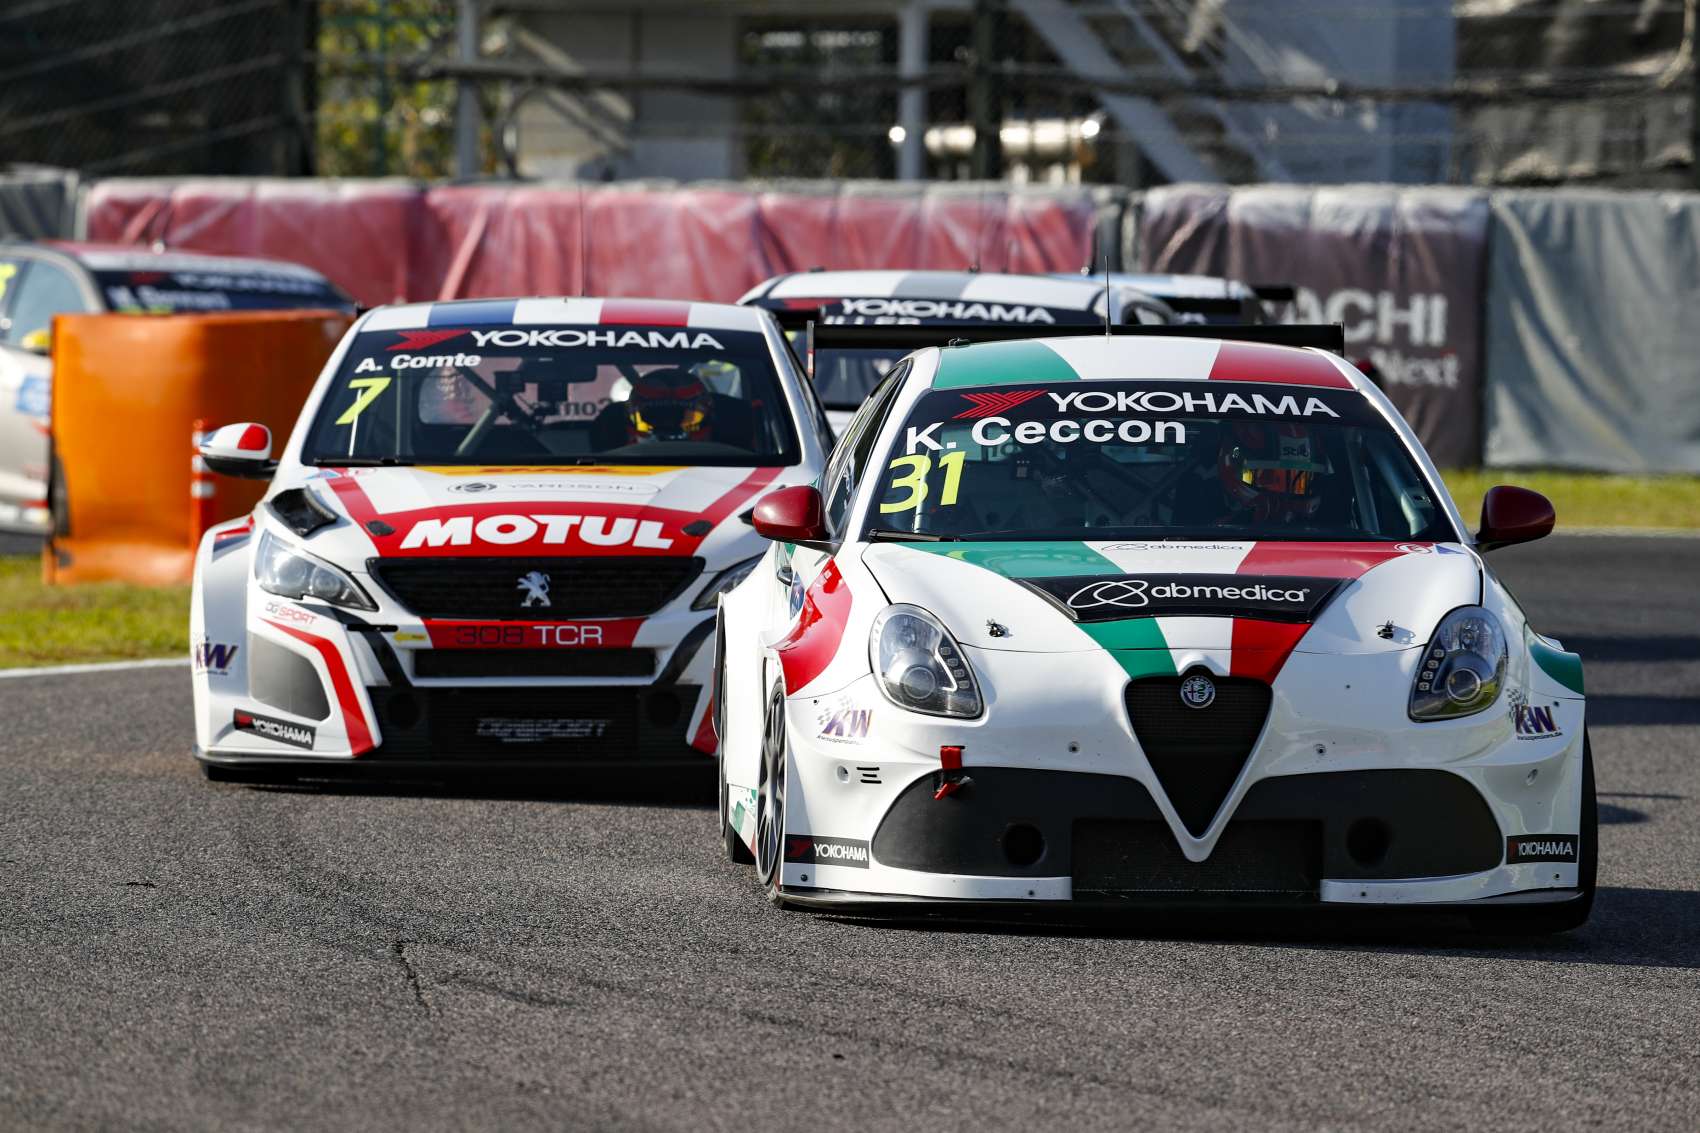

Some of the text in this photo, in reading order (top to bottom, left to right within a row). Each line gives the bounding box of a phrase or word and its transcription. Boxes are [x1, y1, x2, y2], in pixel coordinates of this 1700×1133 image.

[840, 298, 1055, 323] YOKOHAMA
[471, 330, 725, 350] YOKOHAMA
[354, 353, 481, 374] A. Comte
[335, 377, 392, 425] 7
[1048, 391, 1341, 418] YOKOHAMA
[906, 421, 957, 455] K.
[971, 417, 1185, 446] Ceccon
[880, 451, 966, 514] 31
[399, 514, 675, 550] MOTUL
[455, 625, 603, 646] 308 TCR
[252, 718, 313, 745] YOKOHAMA
[821, 708, 873, 738] KW
[1514, 703, 1558, 734] KW
[813, 843, 868, 862] YOKOHAMA
[1517, 841, 1574, 856] YOKOHAMA
